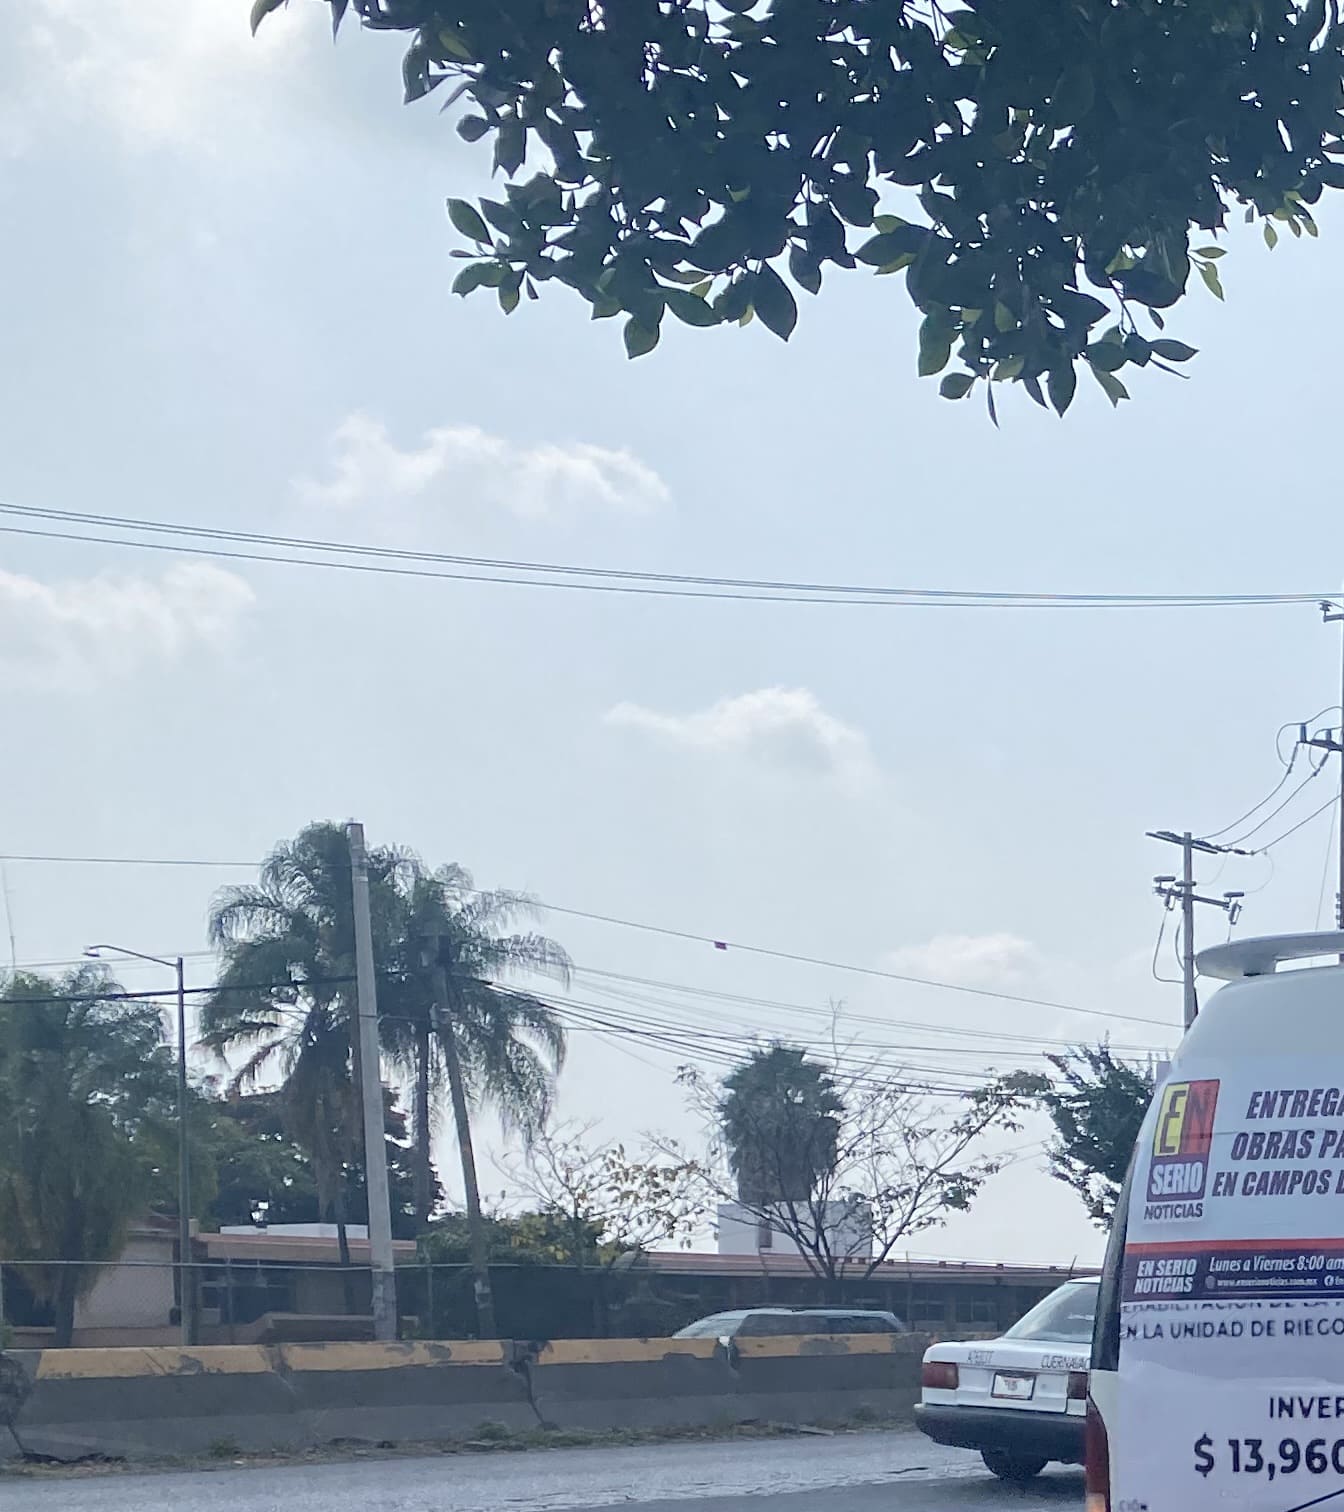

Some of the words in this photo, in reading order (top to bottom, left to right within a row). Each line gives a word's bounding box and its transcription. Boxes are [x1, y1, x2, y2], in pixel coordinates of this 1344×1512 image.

[1230, 1130, 1315, 1161] OBRAS
[1150, 1161, 1203, 1196] SERIO
[1211, 1171, 1238, 1197] EN
[1241, 1168, 1332, 1196] CAMPOS
[1143, 1202, 1204, 1220] NOTICIAS
[1137, 1260, 1155, 1277] EN
[1157, 1258, 1198, 1277] SERIO
[1209, 1256, 1241, 1273] Lunes
[1243, 1261, 1252, 1272] a
[1253, 1255, 1295, 1272] Viernes
[1297, 1254, 1325, 1271] 8:00
[1134, 1277, 1194, 1294] NOTICIAS
[1143, 1323, 1164, 1339] LA
[1171, 1320, 1244, 1339] UNIDAD
[1251, 1319, 1275, 1337] DE
